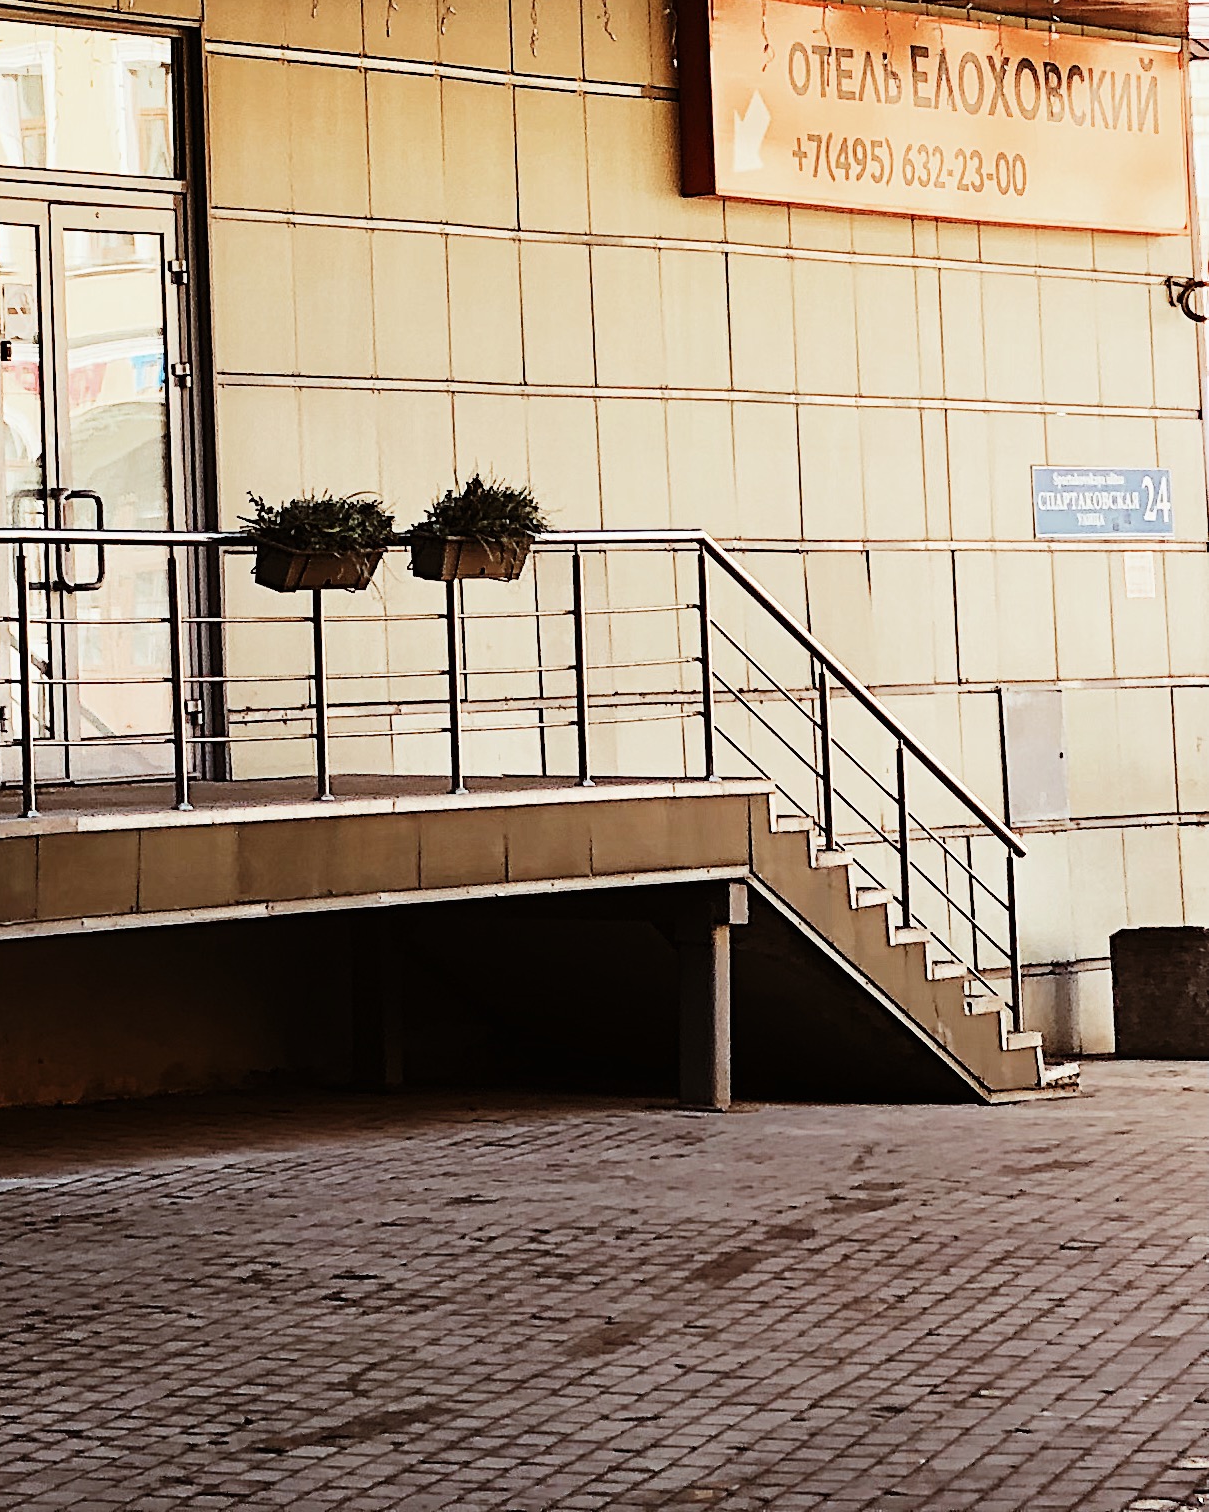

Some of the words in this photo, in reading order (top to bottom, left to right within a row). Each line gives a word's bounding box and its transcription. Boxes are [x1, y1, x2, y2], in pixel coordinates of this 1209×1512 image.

[788, 42, 903, 105] ОТЕЛЬ
[910, 44, 1160, 135] ЕЛОХОВСКИЙ
[792, 132, 894, 186] +7(495)
[903, 144, 1027, 197] 632-23-00
[1037, 491, 1140, 511] СПАРТАКОВСКАЯ
[1141, 475, 1171, 523] 24
